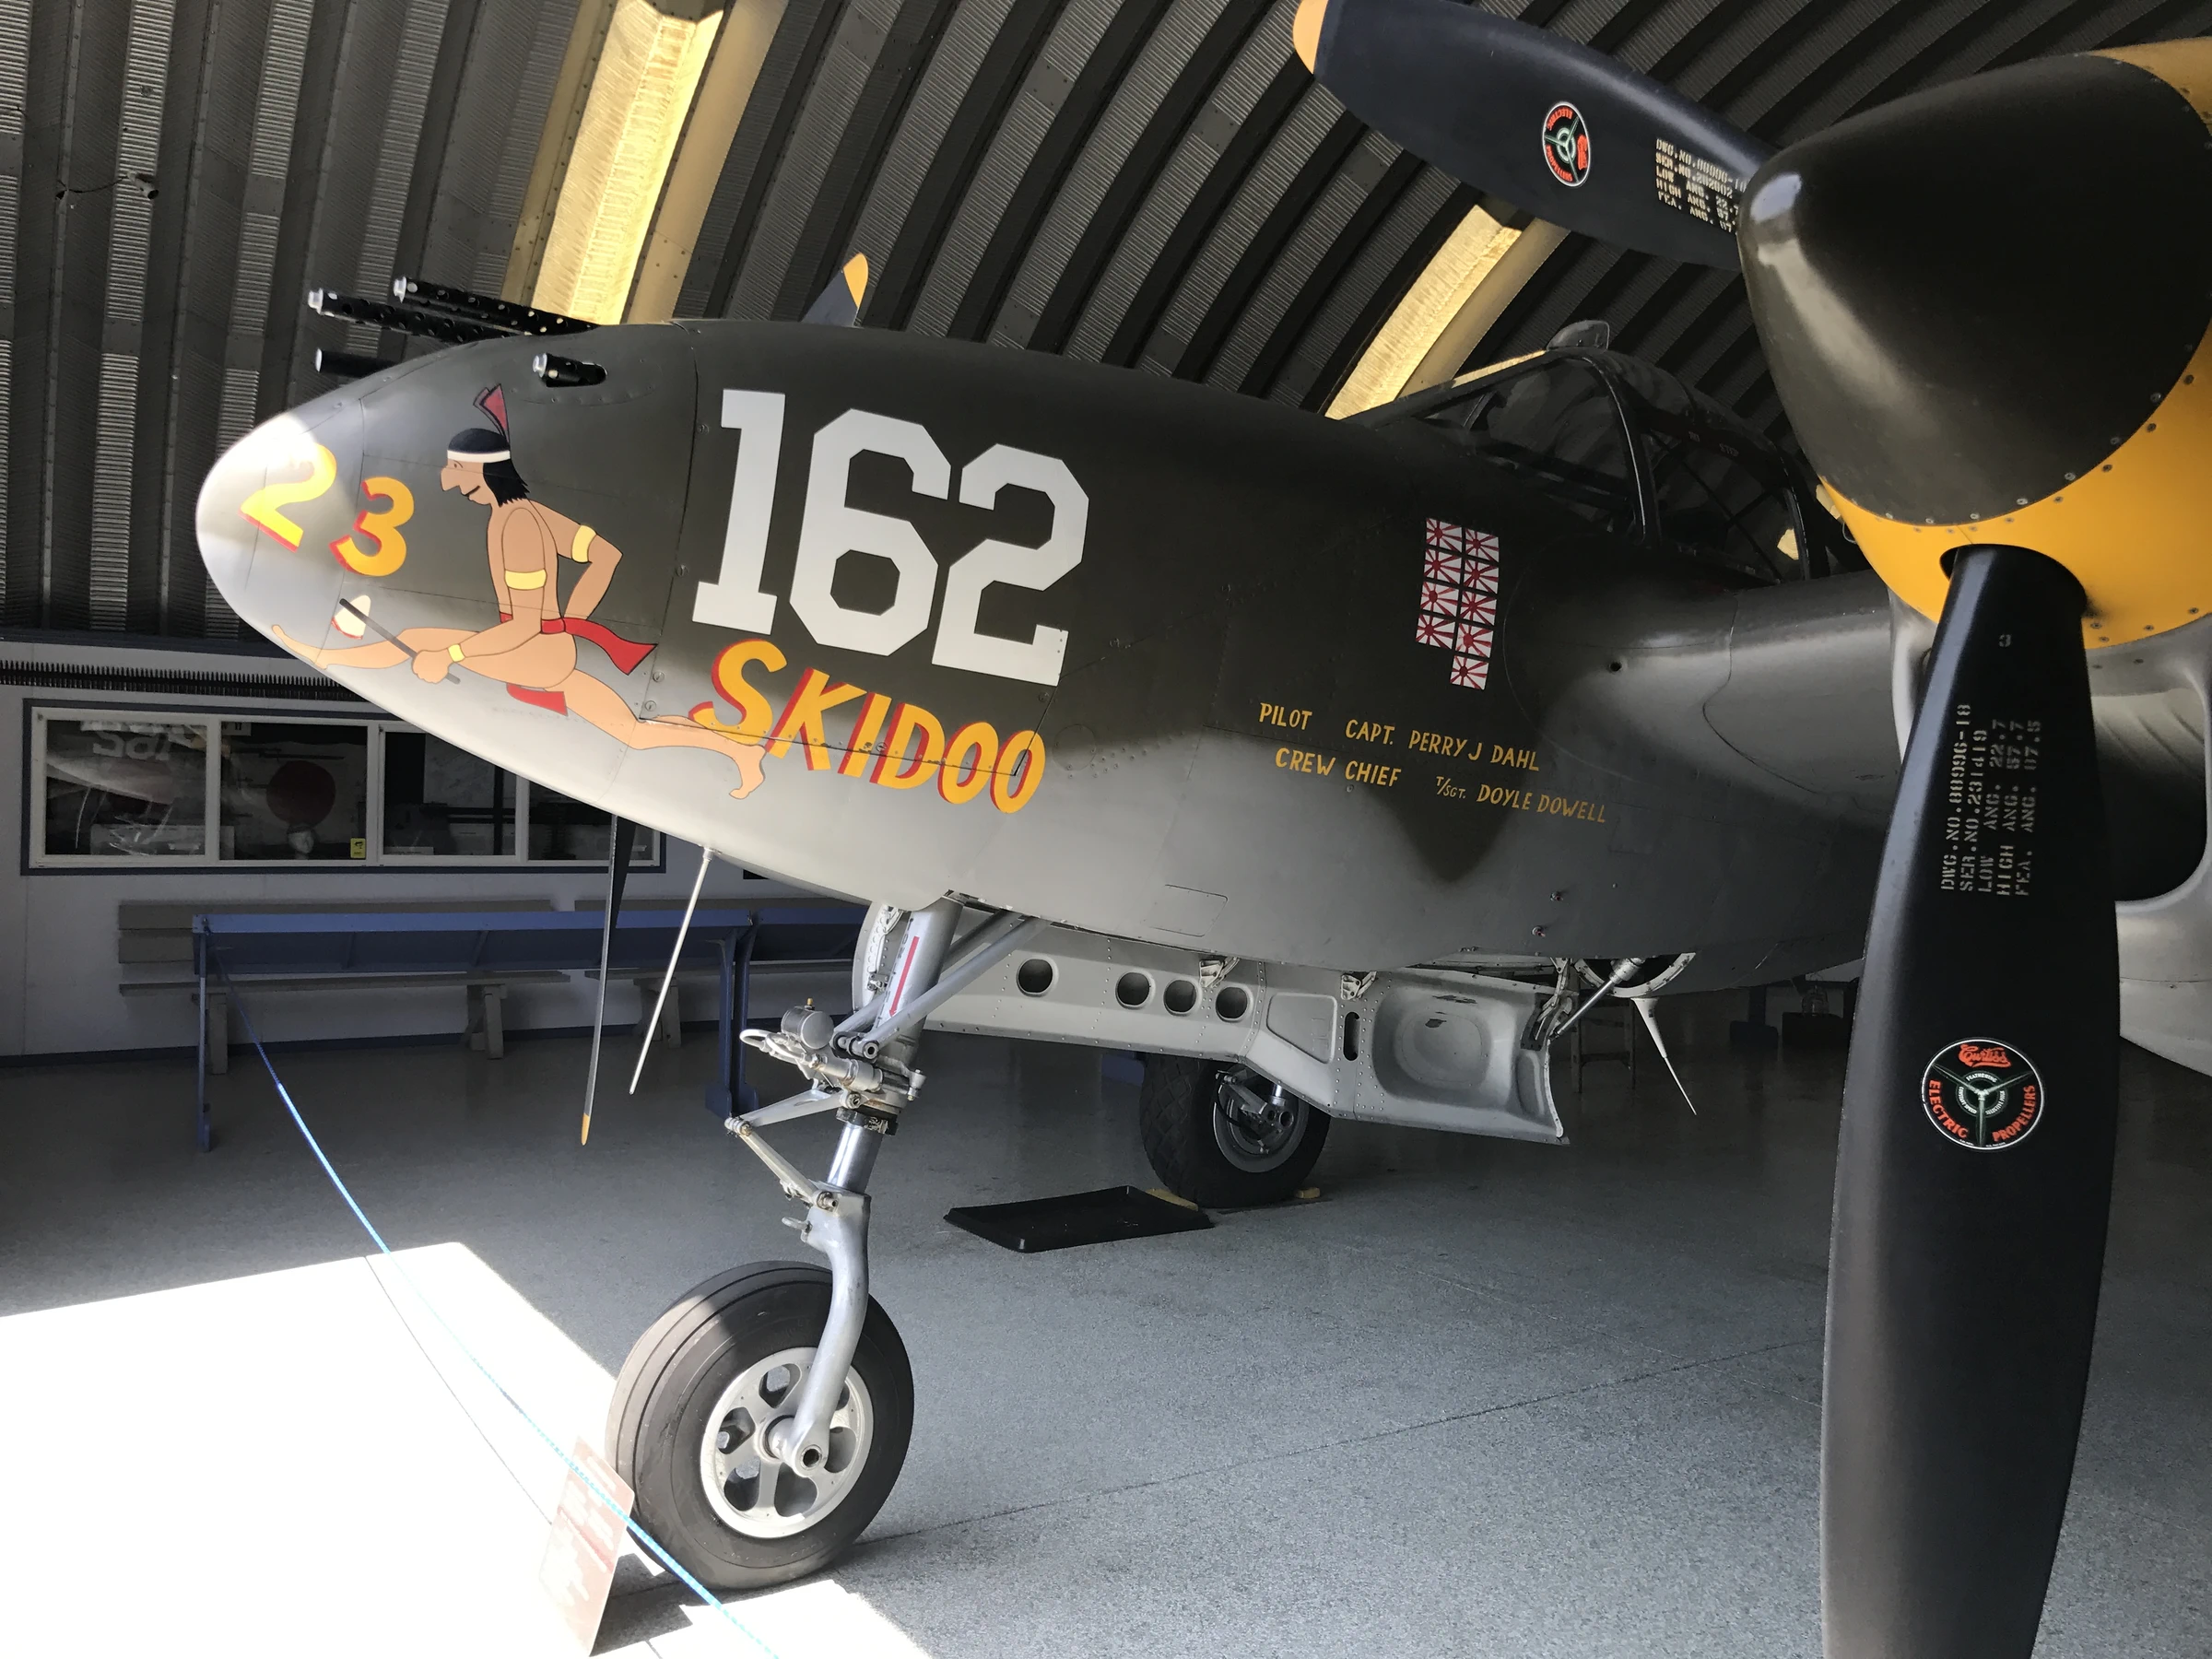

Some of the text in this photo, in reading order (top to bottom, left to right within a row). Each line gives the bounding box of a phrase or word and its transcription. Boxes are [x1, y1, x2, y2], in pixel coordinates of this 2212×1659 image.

[1656, 165, 1675, 182] LOW
[1686, 180, 1710, 201] ANG.
[1656, 178, 1682, 198] HIGH
[1687, 193, 1712, 213] ANG.
[1689, 206, 1714, 225] ANG.
[692, 389, 1088, 686] 162
[688, 639, 1046, 814] SKIDOO
[1258, 701, 1540, 772] PILOT CAPT. PERRY J DAHL
[1275, 747, 1335, 777] CREW
[1345, 760, 1402, 788] CHIEF
[1477, 783, 1532, 810] DOYLE
[1536, 794, 1606, 823] DOWELL
[1978, 718, 2006, 892] LOW ANG. 22.7
[2002, 785, 2019, 831] ANG.
[2020, 786, 2037, 833] ANG.
[1996, 844, 2015, 896] HIGH
[1959, 1044, 2011, 1067] Curtiss
[1929, 1079, 1969, 1138] ELECTRIC
[1992, 1086, 2036, 1142] PROPELLERS
